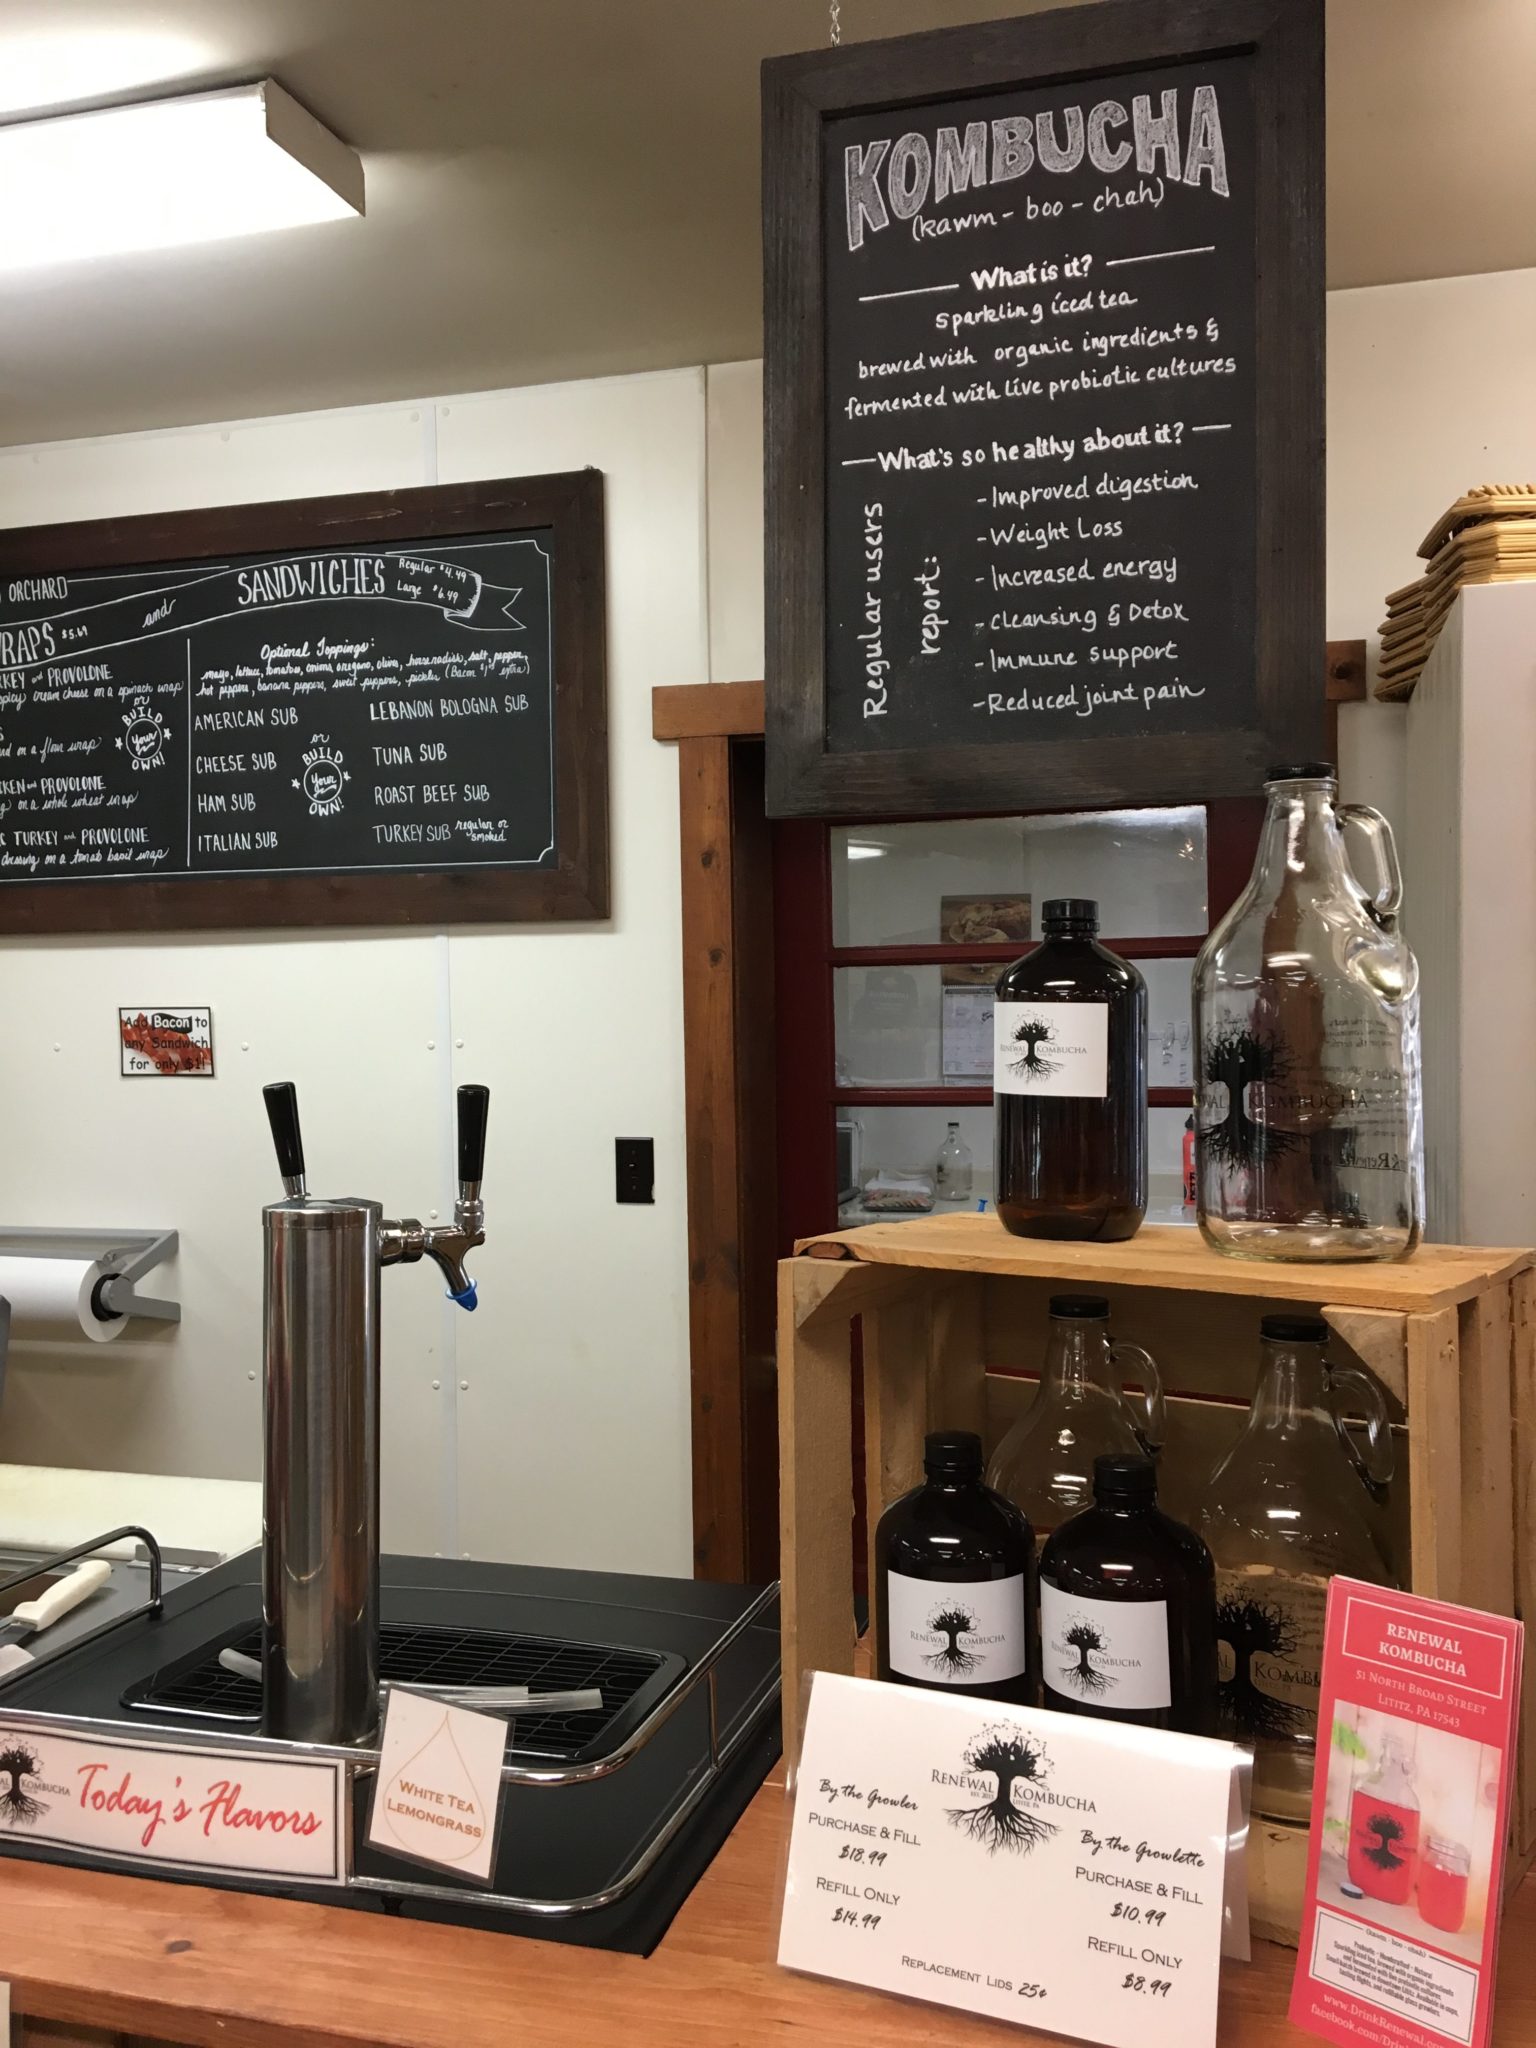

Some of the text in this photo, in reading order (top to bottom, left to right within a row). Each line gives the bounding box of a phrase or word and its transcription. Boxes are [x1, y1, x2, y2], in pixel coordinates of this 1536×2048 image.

[845, 85, 1229, 251] KOMBUCHA
[912, 177, 1165, 241] (kawm boo chah)
[970, 252, 1093, 291] What is it?
[935, 290, 1139, 335] sparkling iced tea
[858, 317, 1220, 380] brewed with organic ingredients &
[844, 354, 1237, 420] fermented with live probiotic cultures
[877, 421, 1184, 473] What's so healthy about it?
[1095, 470, 1199, 501] digestion
[1077, 517, 1123, 540] Loss
[237, 558, 386, 605] SANDWICHES
[399, 558, 467, 583] Regular $4.49
[1102, 556, 1178, 583] energy
[8, 576, 68, 602] ORCHARD
[397, 580, 459, 604] Large $6.49
[142, 598, 176, 629] and
[857, 502, 891, 720] Regular users
[914, 555, 949, 656] report:
[1107, 600, 1190, 626] & Detox
[0, 621, 56, 666] RAPS
[260, 637, 376, 664] Optional Toppings:
[1089, 640, 1179, 668] support
[47, 664, 113, 688] PROVOLONE
[196, 682, 214, 697] hot
[257, 678, 291, 692] banana
[332, 675, 357, 689] sweet
[406, 670, 441, 688] pickles
[369, 694, 529, 721] LEBANON BOLOGNA SUB
[1075, 679, 1139, 717] joint
[1142, 676, 1207, 710] pain
[122, 705, 163, 727] BUILD
[194, 706, 299, 732] AMERICAN SUB
[310, 733, 330, 744] or
[131, 751, 166, 771] OWN!
[196, 751, 278, 774] CHEESE SUB
[301, 746, 344, 767] BUILD
[371, 742, 448, 767] TUNA SUB
[41, 775, 107, 796] PROVOLONE
[374, 783, 490, 806] ROAST BEEF SUB
[42, 793, 69, 811] whole
[71, 793, 104, 808] wheat
[197, 792, 257, 814] HAM SUB
[308, 796, 345, 817] OWN!
[13, 826, 151, 847] TURKEY PROVOLONE
[197, 831, 279, 853] ITALIAN SUB
[371, 818, 510, 843] TURKEY SUB regular or
[470, 830, 508, 843] smoked
[124, 1014, 209, 1029] Add Bacon to
[124, 1036, 209, 1053] any Sandwich
[1036, 1044, 1088, 1055] KOMBUCHA
[129, 1056, 180, 1074] for only
[1247, 1093, 1369, 1110] KOMBUCHA
[910, 1629, 1007, 1647] RENEWAL KOMBUCHA
[1387, 1622, 1463, 1655] RENEWAL
[1088, 1653, 1142, 1669] KOMBUCHA
[1378, 1641, 1468, 1677] KOMBUCHA
[1356, 1669, 1366, 1680] 51
[1416, 1703, 1431, 1719] PA
[1433, 1711, 1461, 1729] 17543
[398, 1779, 476, 1815] WHITE TEA
[819, 1777, 919, 1813] By the Growler
[931, 1768, 1098, 1814] RENEWAL KOMBUCHA
[21, 1763, 323, 1848] KOMBUCHA Today's Flavors
[387, 1799, 483, 1839] LEMONGRASS
[880, 1826, 891, 1840] &
[838, 1844, 889, 1867] $18.99
[1080, 1828, 1207, 1870] By the Growlette
[1156, 1882, 1169, 1898] &
[831, 1906, 882, 1931] $14.99
[1110, 1902, 1167, 1928] $10.99
[1017, 1982, 1048, 1999] 25¢
[1121, 1972, 1173, 1998] $8.99
